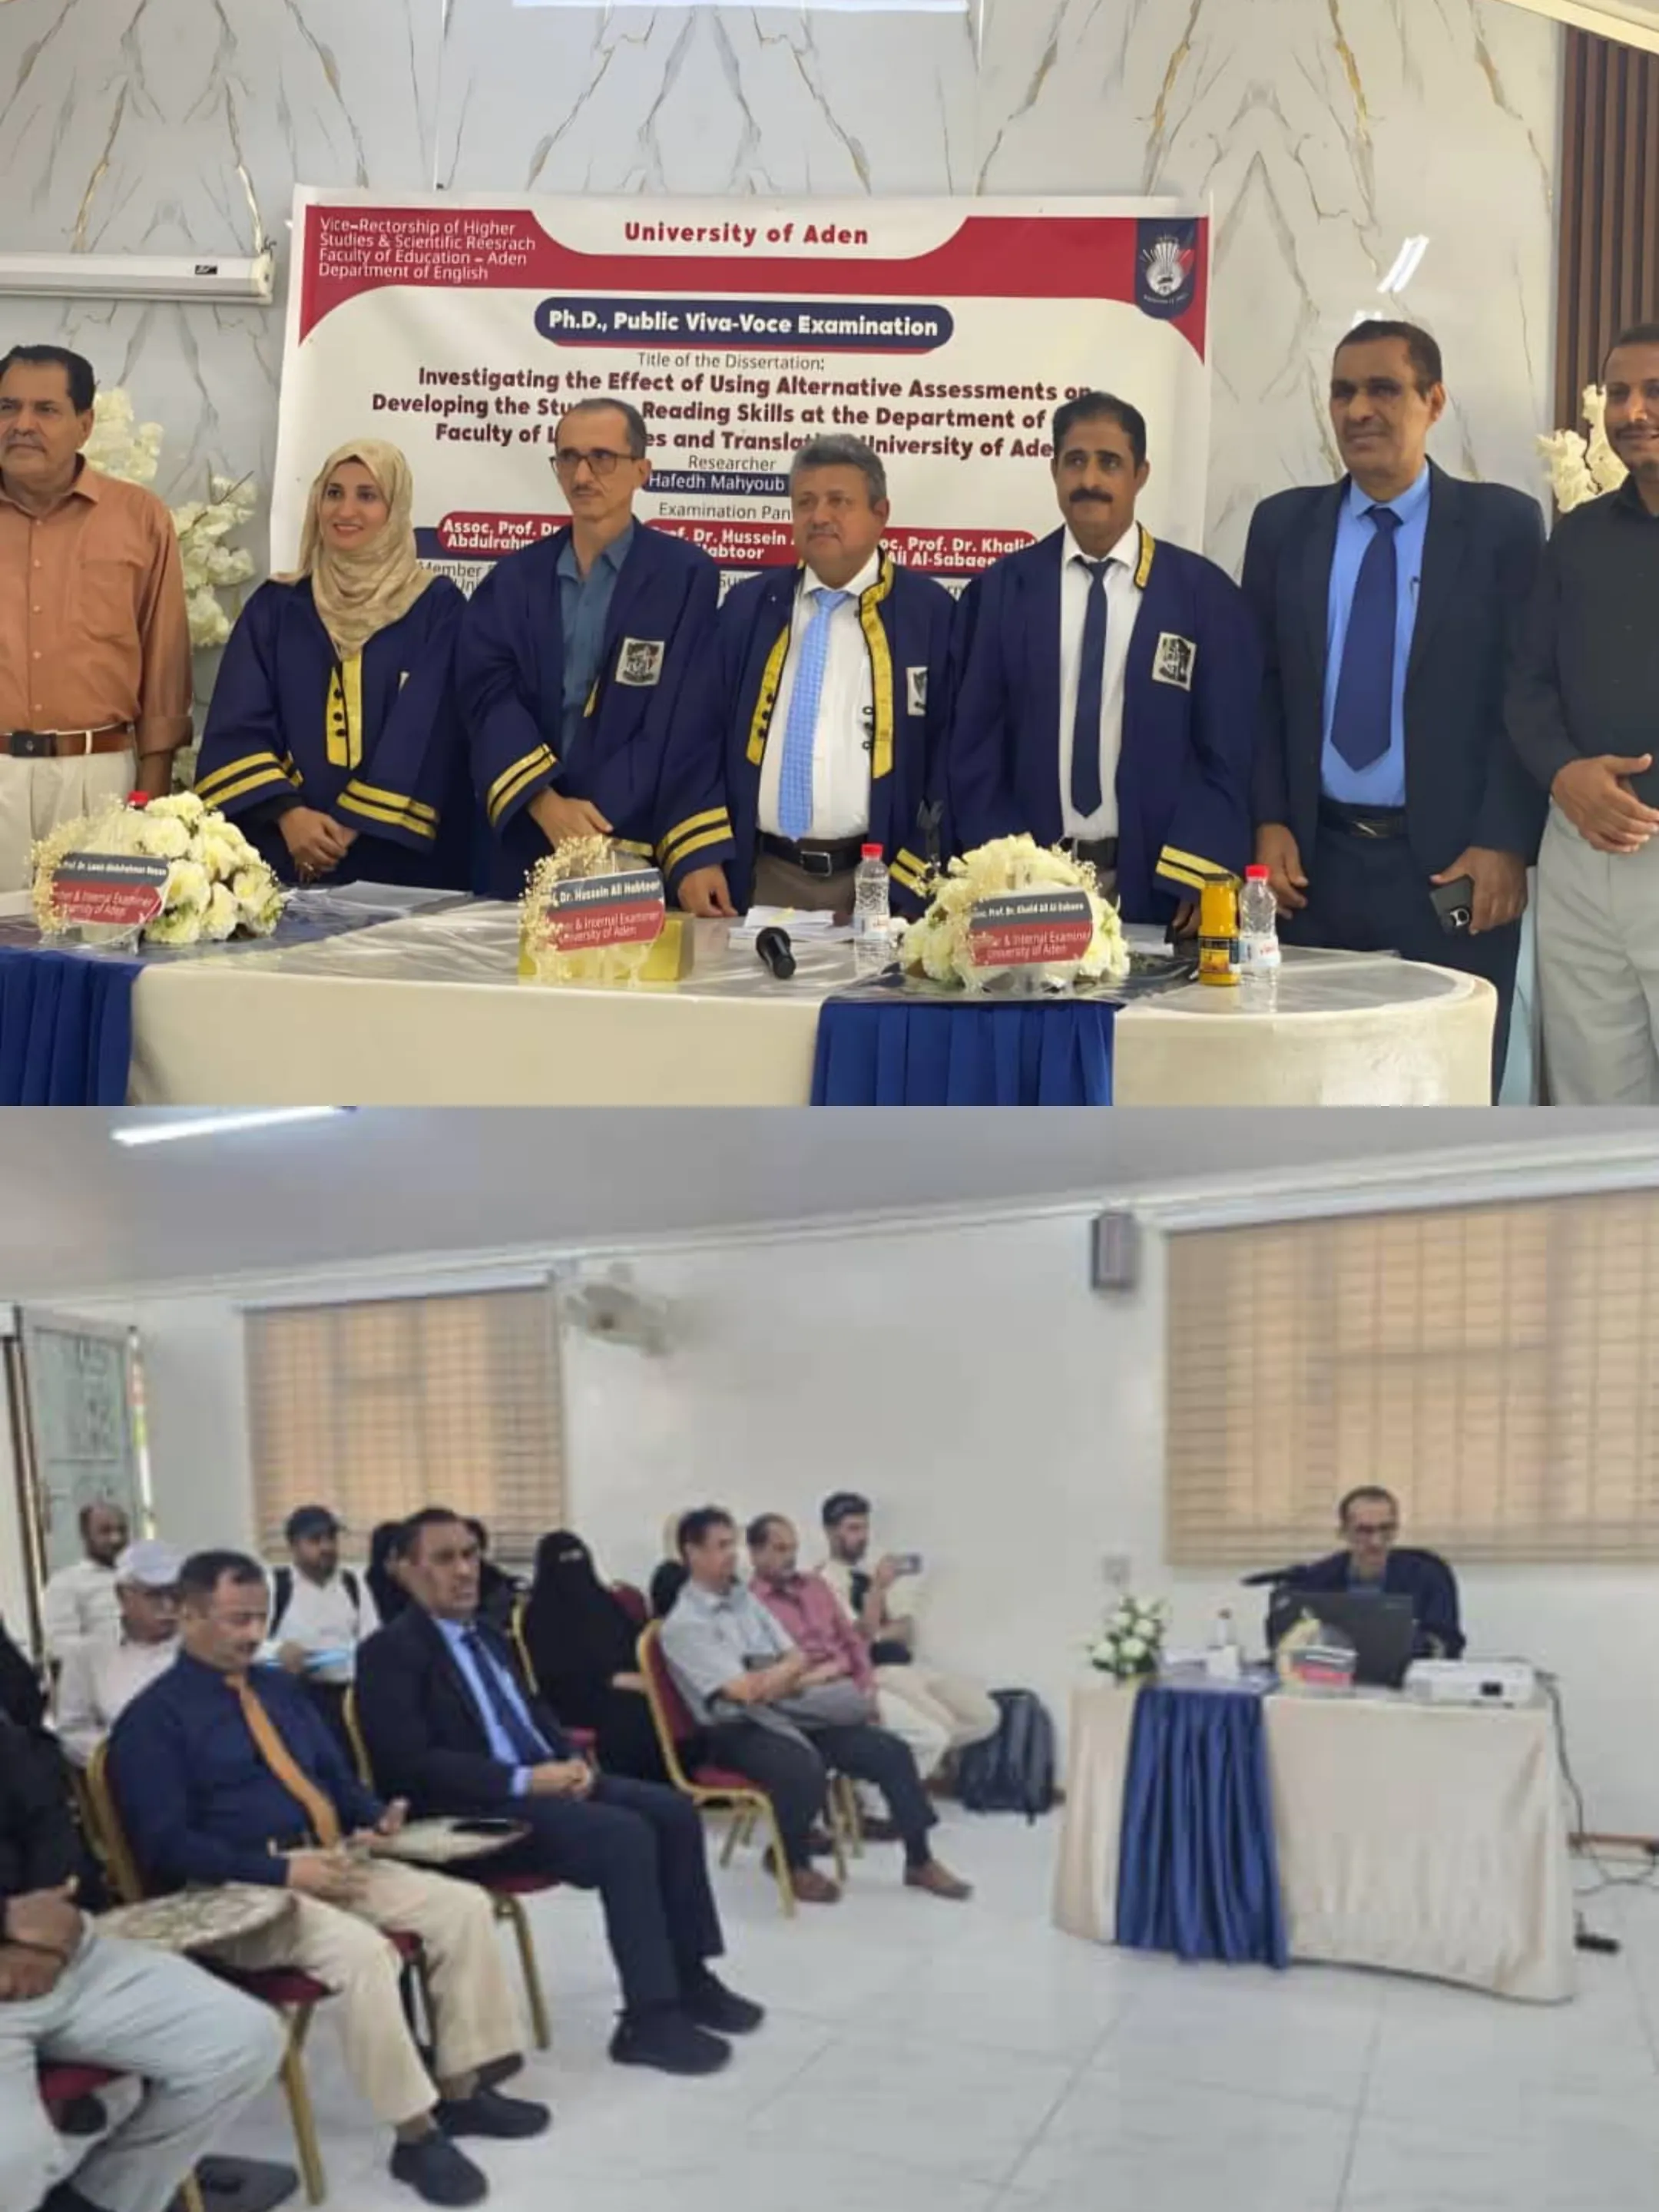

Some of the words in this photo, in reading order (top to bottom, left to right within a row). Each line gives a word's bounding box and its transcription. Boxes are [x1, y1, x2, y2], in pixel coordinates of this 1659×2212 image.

[444, 220, 459, 233] of
[464, 221, 515, 237] Higher
[624, 222, 756, 247] University
[767, 224, 793, 243] of
[803, 225, 868, 244] Aden
[320, 233, 373, 247] Studies
[379, 235, 390, 247] &
[396, 235, 462, 249] Scientific
[466, 237, 535, 250] Reesrach
[320, 248, 370, 265] Faculty
[375, 249, 390, 261] of
[396, 250, 470, 263] Education
[487, 252, 526, 266] Aden
[320, 263, 408, 279] Department
[413, 265, 429, 278] of
[434, 267, 488, 283] English
[549, 310, 607, 332] Ph.D.,
[614, 311, 678, 331] Public
[685, 313, 792, 333] Viva-Voce
[798, 315, 938, 336] Examination
[637, 353, 671, 367] Title
[675, 353, 691, 367] of
[694, 354, 720, 368] the
[419, 367, 559, 392] Investigating
[565, 371, 601, 389] the
[609, 373, 674, 391] Effect
[682, 374, 704, 392] of
[710, 375, 770, 397] Using
[777, 377, 902, 397] Alternative
[909, 379, 1057, 400] Assessments
[373, 394, 488, 418] Developing
[495, 396, 530, 415] the
[642, 402, 730, 426] Reading
[737, 403, 794, 422] Skills
[801, 406, 824, 423] at
[833, 405, 869, 424] the
[876, 407, 1015, 430] Department
[1023, 409, 1047, 428] of
[435, 423, 512, 446] Faculty
[519, 425, 541, 443] of
[674, 430, 714, 448] and
[980, 438, 1004, 456] of
[1010, 439, 1053, 458] Ade
[688, 455, 777, 472] Researcher
[648, 473, 706, 489] Hafedh
[711, 475, 785, 494] Mahyoub
[659, 502, 756, 519] Examination
[761, 505, 790, 520] Pan
[442, 519, 493, 535] Assoc.
[498, 521, 537, 536] Prof.
[541, 524, 562, 536] Dr
[447, 535, 535, 550] Abdulrahm
[694, 529, 717, 543] Dr.
[722, 529, 786, 545] Hussein
[908, 538, 947, 551] Prof.
[952, 538, 976, 552] Dr.
[697, 544, 765, 559] abtoor
